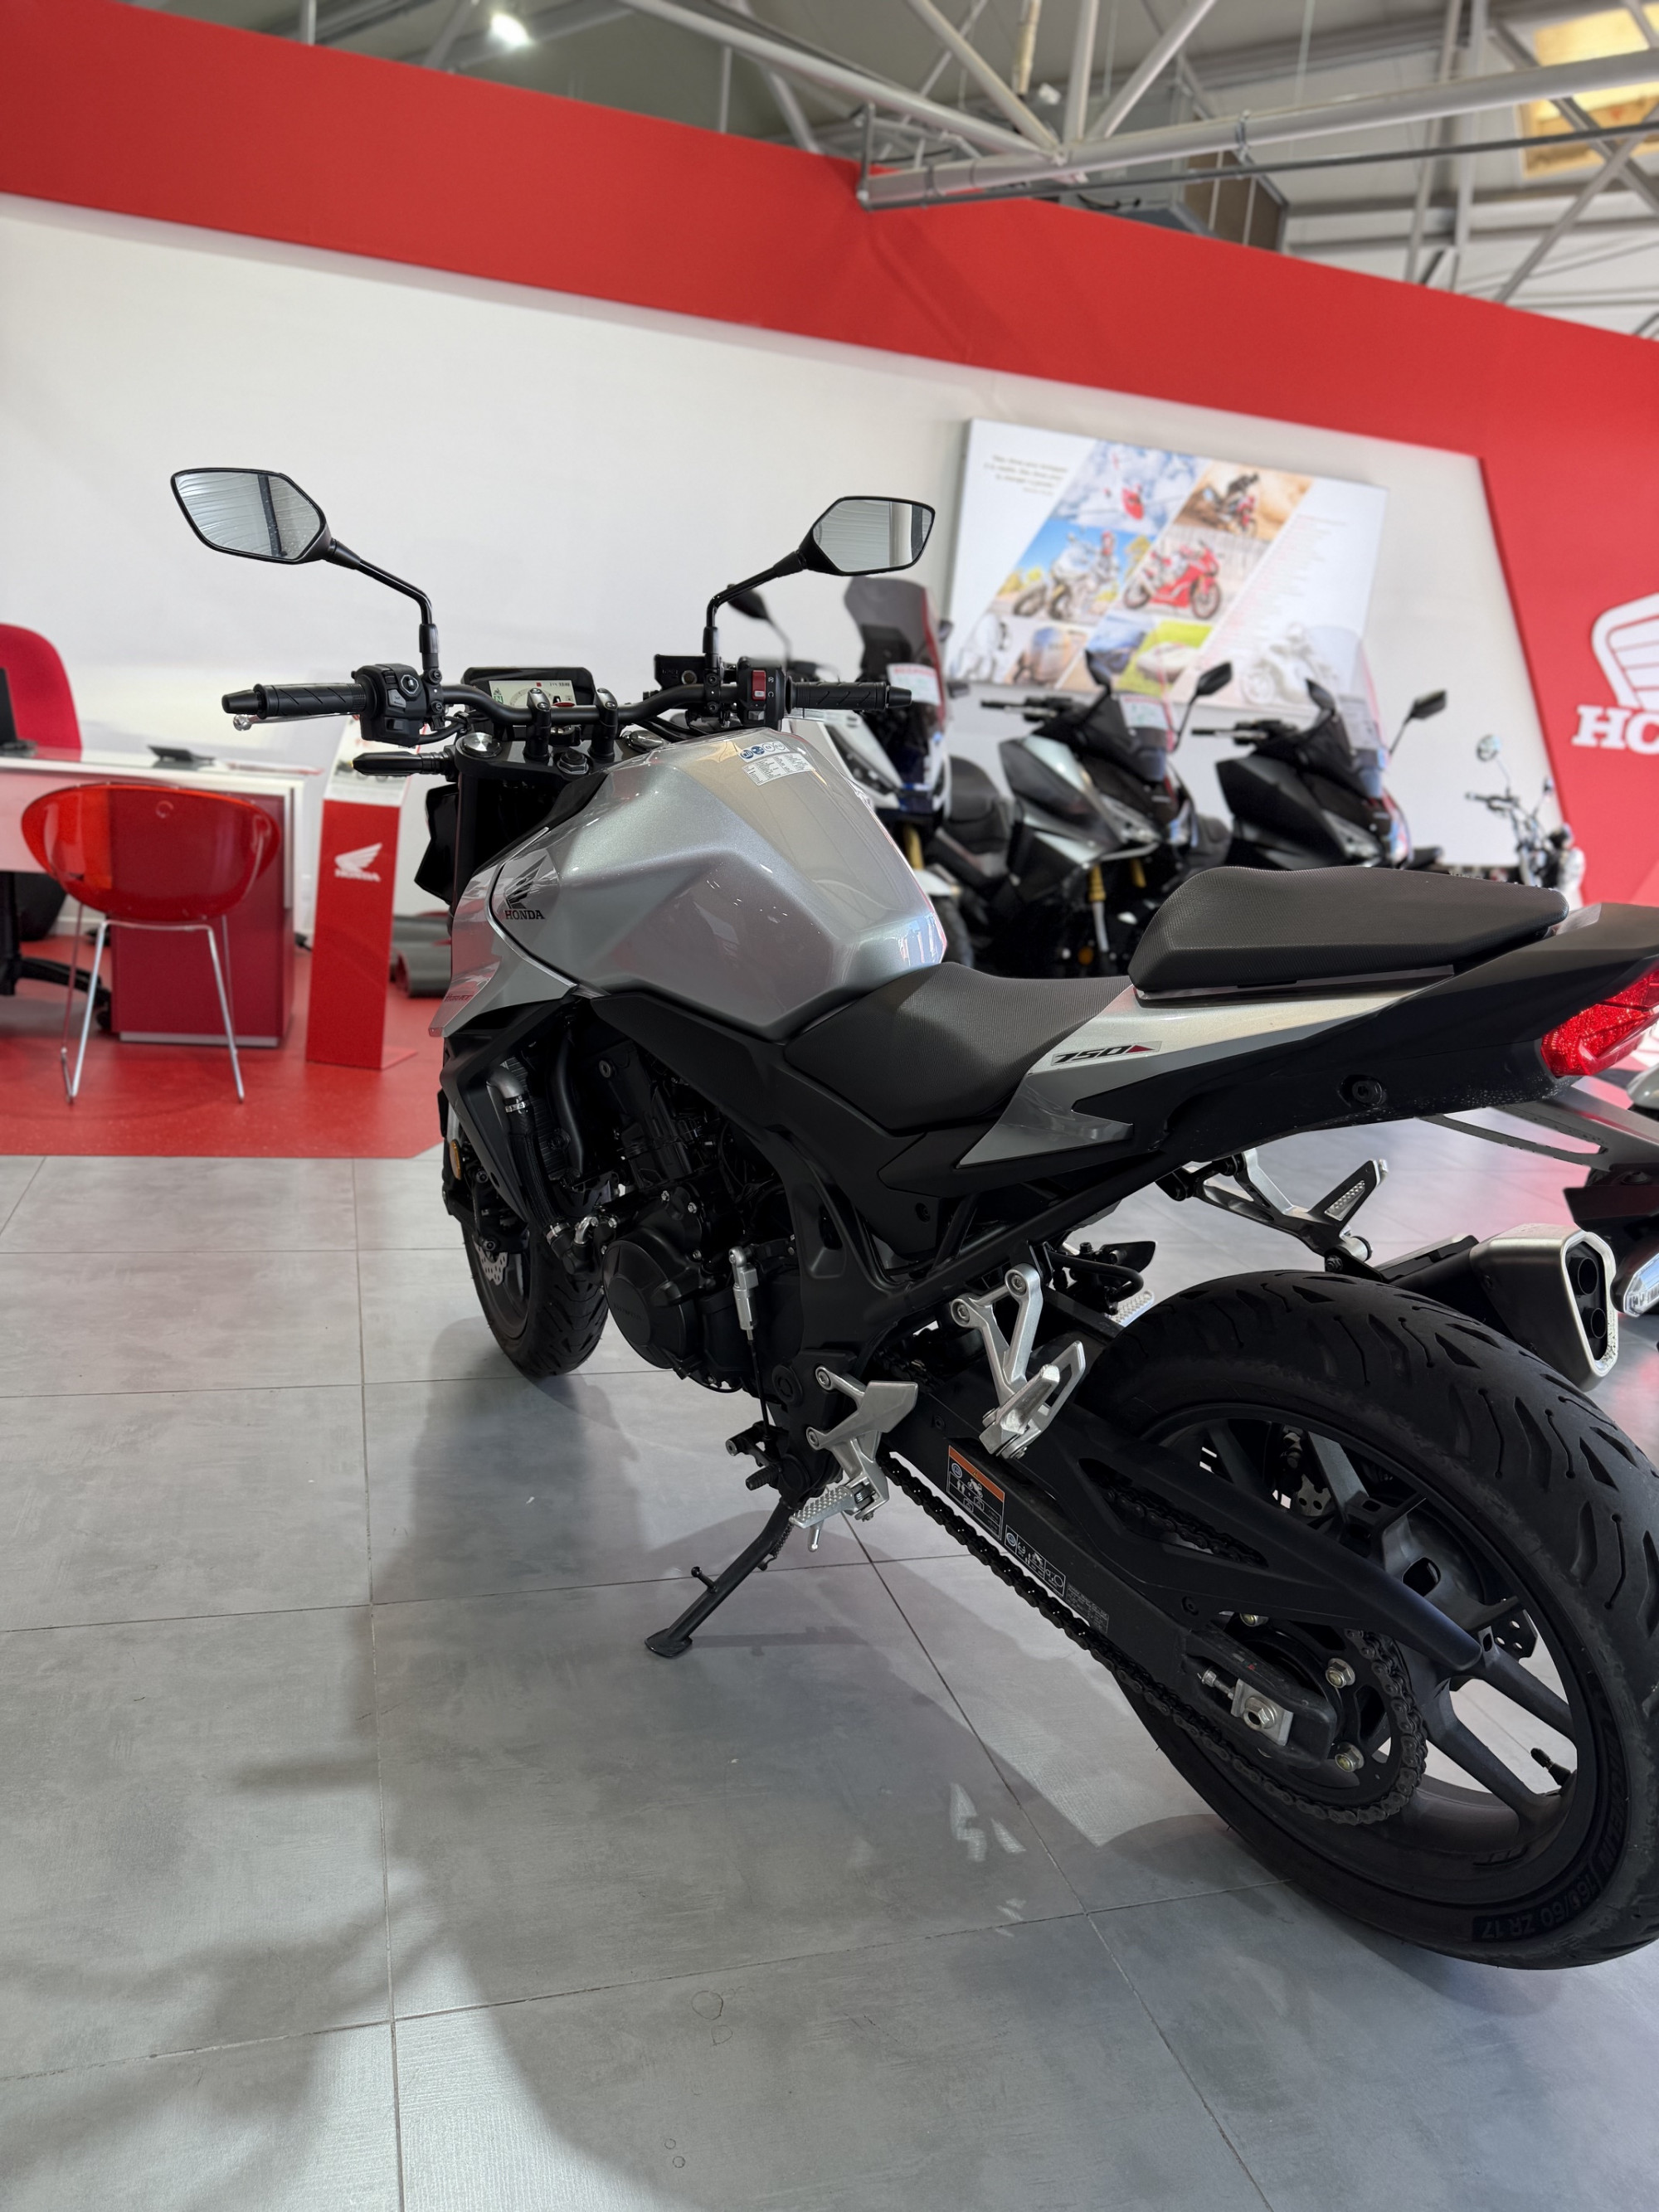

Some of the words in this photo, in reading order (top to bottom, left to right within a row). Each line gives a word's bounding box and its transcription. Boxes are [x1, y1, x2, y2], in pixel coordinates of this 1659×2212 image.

[504, 910, 545, 920] HONDA
[1053, 1045, 1132, 1064] 750
[1540, 1874, 1598, 1928] 160/60
[1481, 1918, 1506, 1939] 17
[1508, 1913, 1535, 1937] ZR
